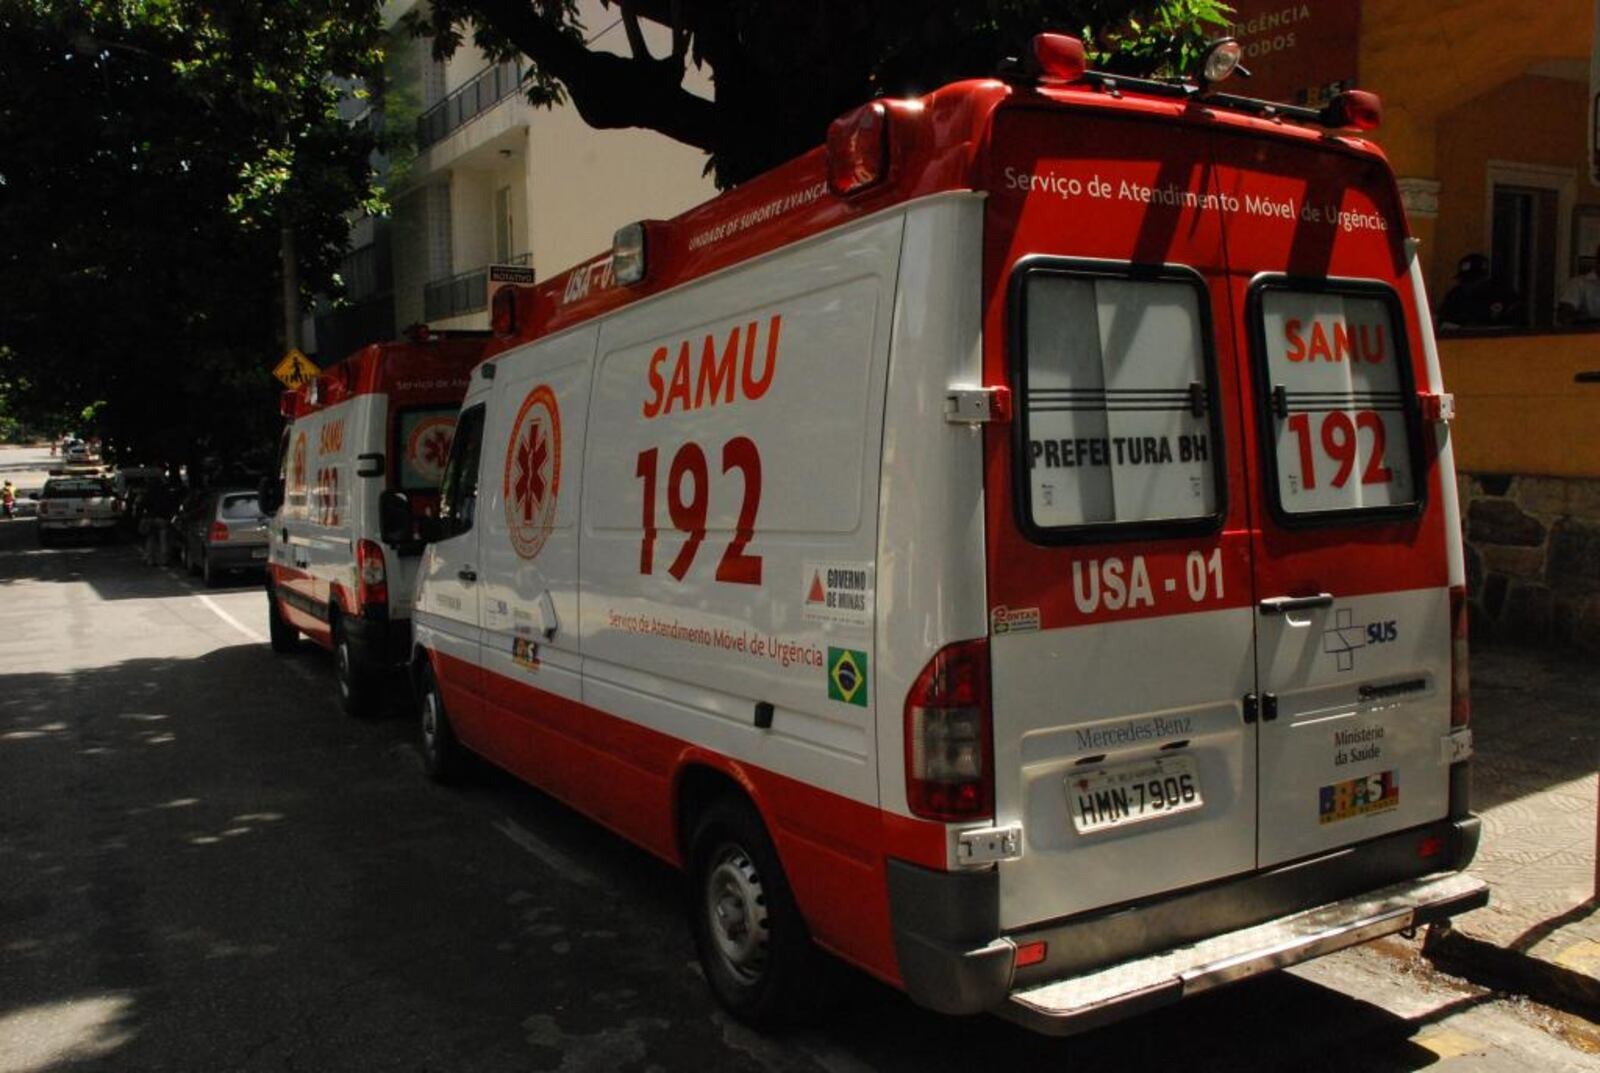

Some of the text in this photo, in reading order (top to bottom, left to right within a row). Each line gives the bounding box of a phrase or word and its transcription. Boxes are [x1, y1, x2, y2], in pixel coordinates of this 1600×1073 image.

[740, 200, 782, 231] SUPORTE
[782, 180, 830, 211] AVANÇA
[1004, 165, 1389, 232] Serviço de Atendimento Móvel de Urgência
[644, 314, 782, 418] SAMU
[1285, 319, 1385, 365] SAMU
[319, 419, 345, 457] SAMU
[1028, 434, 1207, 469] PREFEITURA BH
[1288, 408, 1393, 491] 192
[317, 466, 339, 526] 192
[636, 436, 763, 586] 192
[826, 591, 865, 611] DE MINAS
[827, 568, 867, 591] GOVERNO
[1072, 555, 1155, 614] USA
[1186, 547, 1225, 602] 01
[609, 609, 823, 668] Serviço de Atendimento Móvel de Urgência
[1367, 620, 1398, 645] SUS
[1076, 716, 1191, 750] Mercedes-Benz
[1335, 742, 1381, 766] da Saúde
